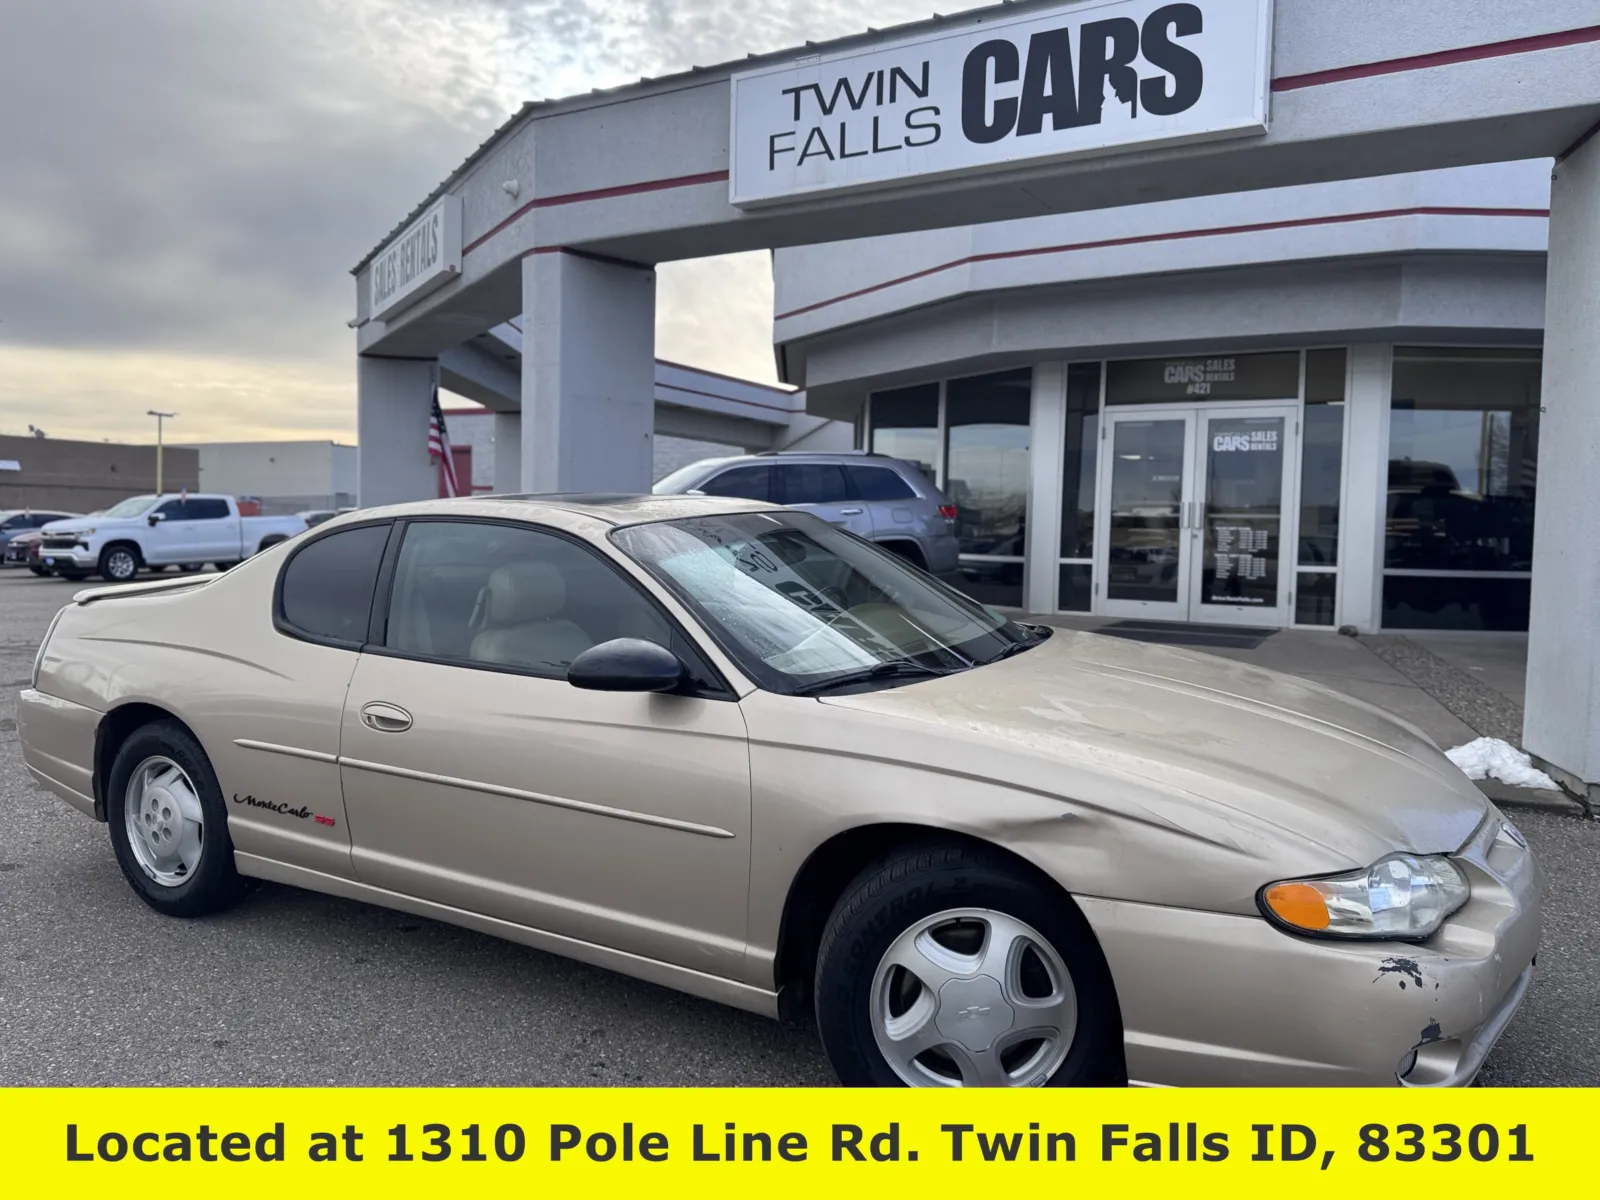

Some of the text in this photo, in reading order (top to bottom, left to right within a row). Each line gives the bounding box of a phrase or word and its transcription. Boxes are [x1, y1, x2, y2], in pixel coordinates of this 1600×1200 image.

[961, 2, 1203, 144] CARS
[781, 60, 930, 121] TWIN
[769, 106, 942, 171] FALLS
[374, 214, 439, 306] SALES RENTALS
[1164, 365, 1204, 383] CARS
[1206, 359, 1236, 371] SALES
[1186, 383, 1211, 395] #421
[1213, 436, 1250, 451] CARS
[1250, 431, 1278, 442] SALES
